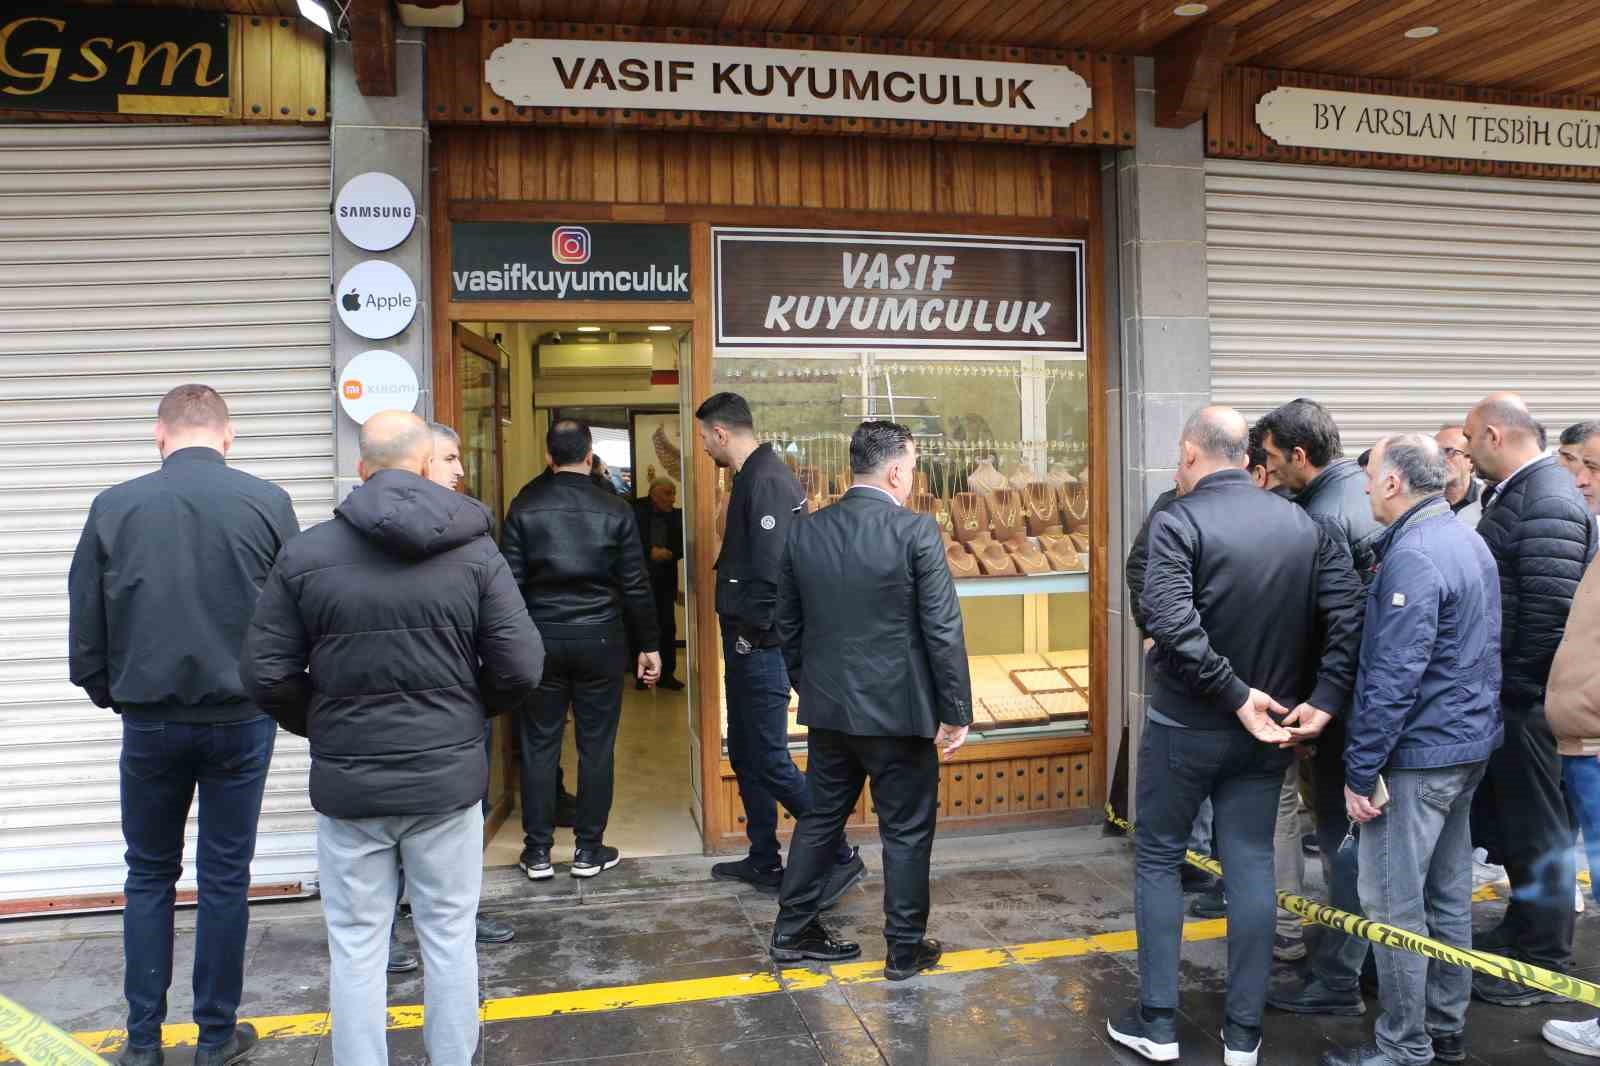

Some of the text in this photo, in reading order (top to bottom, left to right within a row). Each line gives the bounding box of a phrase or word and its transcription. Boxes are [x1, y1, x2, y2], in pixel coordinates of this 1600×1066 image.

[0, 17, 224, 95] Gsm
[552, 56, 1036, 110] VASIF KUYUMCULUK
[1313, 103, 1347, 131] BY
[1355, 107, 1457, 140] ARSLAN
[1466, 115, 1551, 146] TESBİH
[340, 206, 412, 218] SAMSUNG
[452, 263, 689, 298] vasifkuyumculuk
[842, 252, 956, 291] VASIF
[366, 292, 412, 311] Apple
[764, 296, 1051, 336] KUYUMCULUK
